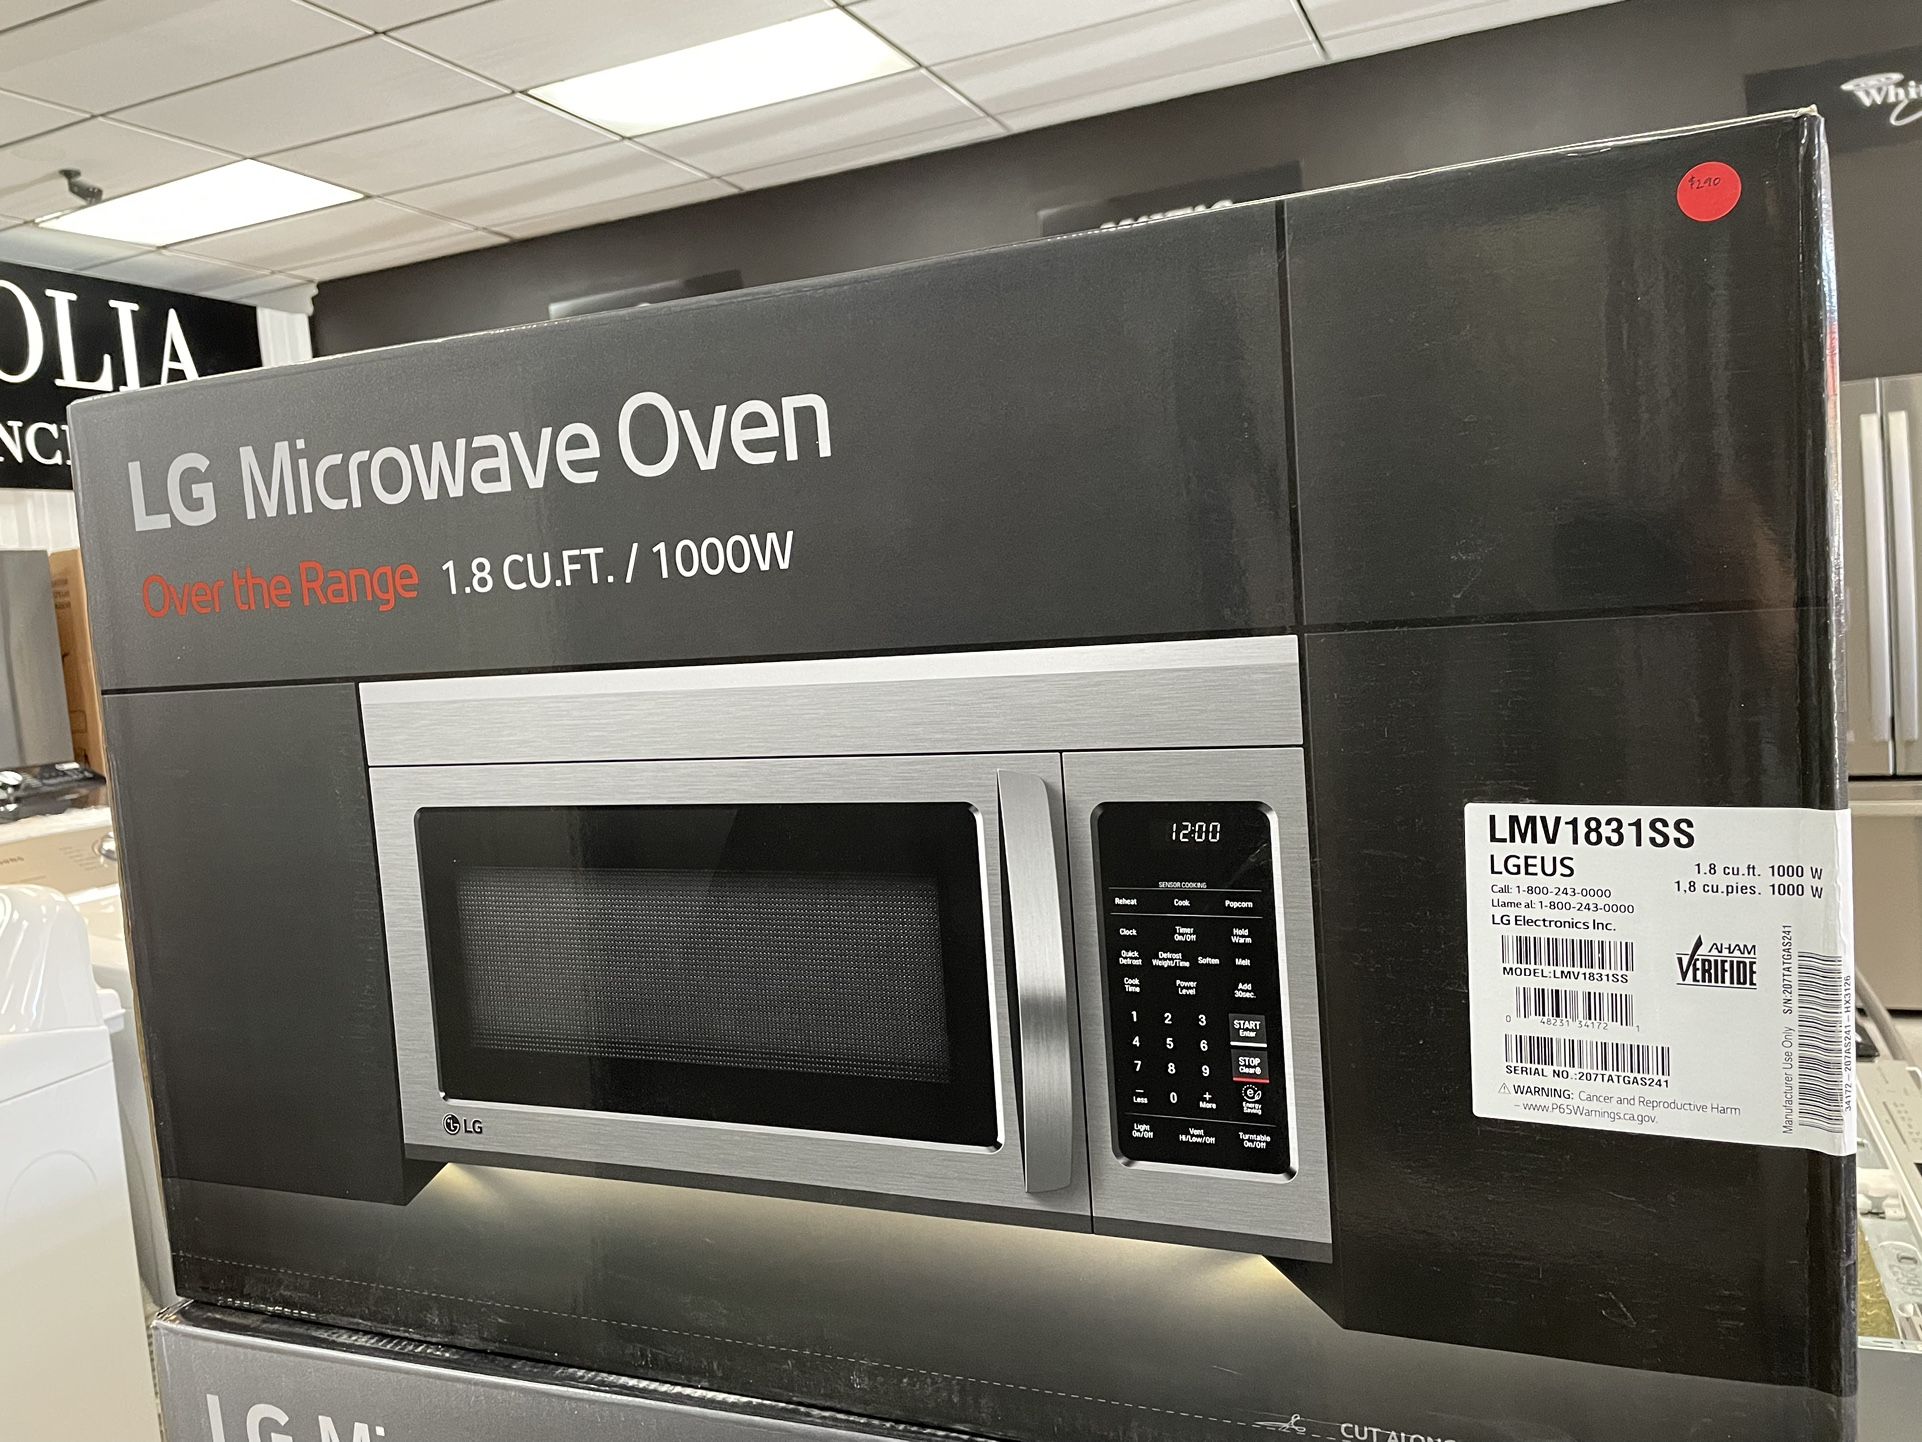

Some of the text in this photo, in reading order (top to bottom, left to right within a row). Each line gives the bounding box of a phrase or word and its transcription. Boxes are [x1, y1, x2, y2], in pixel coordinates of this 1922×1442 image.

[127, 391, 832, 531] LG Microwave Oven
[142, 530, 794, 618] Over the Range 1.8 CU.FT. / 1000W
[1172, 822, 1221, 842] 12:00
[1489, 814, 1695, 849] LMV1831SS
[1490, 854, 1575, 878] LGEUS
[1694, 863, 1823, 880] 1.8 cu.ft. 1000 W
[1491, 884, 1612, 898] Call: 1-800-243-0000
[1675, 880, 1823, 899] 1,8 cu.pies. 1000 W
[1115, 898, 1137, 906] Reheat
[1225, 900, 1253, 909] Popcorn
[1491, 898, 1635, 914] Llame al: 1-800-243-0000
[1491, 914, 1616, 931] LG Electronics Inc.
[1119, 928, 1137, 936] Clock
[1175, 926, 1194, 934] Timer
[1233, 928, 1249, 936] Hold
[1174, 934, 1196, 942] On/Off
[1231, 936, 1252, 944] Warm
[1708, 942, 1757, 956] AHAM
[1119, 957, 1142, 965] Defrost
[1152, 959, 1190, 967] Weight/Time
[1197, 957, 1220, 965] Soften
[1235, 958, 1250, 966] Melt
[1676, 946, 1757, 986] VERIFIDE
[1124, 977, 1140, 985] Cook
[1502, 967, 1629, 984] MODEL:LMV1831SS
[1124, 985, 1140, 993] Time
[1176, 980, 1197, 988] Power
[1237, 983, 1252, 991] Add
[1234, 990, 1256, 998] 30sec.
[1131, 1011, 1138, 1022] 1
[1164, 1013, 1172, 1024] 2
[1198, 1015, 1206, 1026] 3
[1233, 1020, 1260, 1029] START
[1505, 1015, 1641, 1033] 0 48231 34172 1
[1782, 924, 1795, 1134] Manufacturer Use Only S/N:207TATGAS241
[1132, 1036, 1140, 1047] 4
[1166, 1038, 1174, 1049] 5
[1200, 1040, 1208, 1051] 6
[1133, 1061, 1142, 1071] 7
[1238, 1057, 1260, 1066] STOP
[1167, 1063, 1176, 1075] 8
[1202, 1065, 1210, 1076] 9
[1505, 1065, 1669, 1089] SERIAL NO.:207TATGAS241
[1170, 1092, 1177, 1103] 0
[1513, 1084, 1741, 1116] WARNING: Cancer and Reproductive Harm
[1200, 1101, 1216, 1109] More
[1522, 1101, 1658, 1125] www.P65Warnings.ca.gov.
[463, 1118, 483, 1134] LG
[1134, 1123, 1150, 1131] Light
[1132, 1130, 1153, 1138] On/Off
[1189, 1128, 1204, 1136] Vent
[1239, 1132, 1270, 1142] Turntable
[1179, 1135, 1215, 1144] Hi/Low/Off
[1244, 1141, 1266, 1149] On/Off
[1340, 1423, 1381, 1442] CUT
